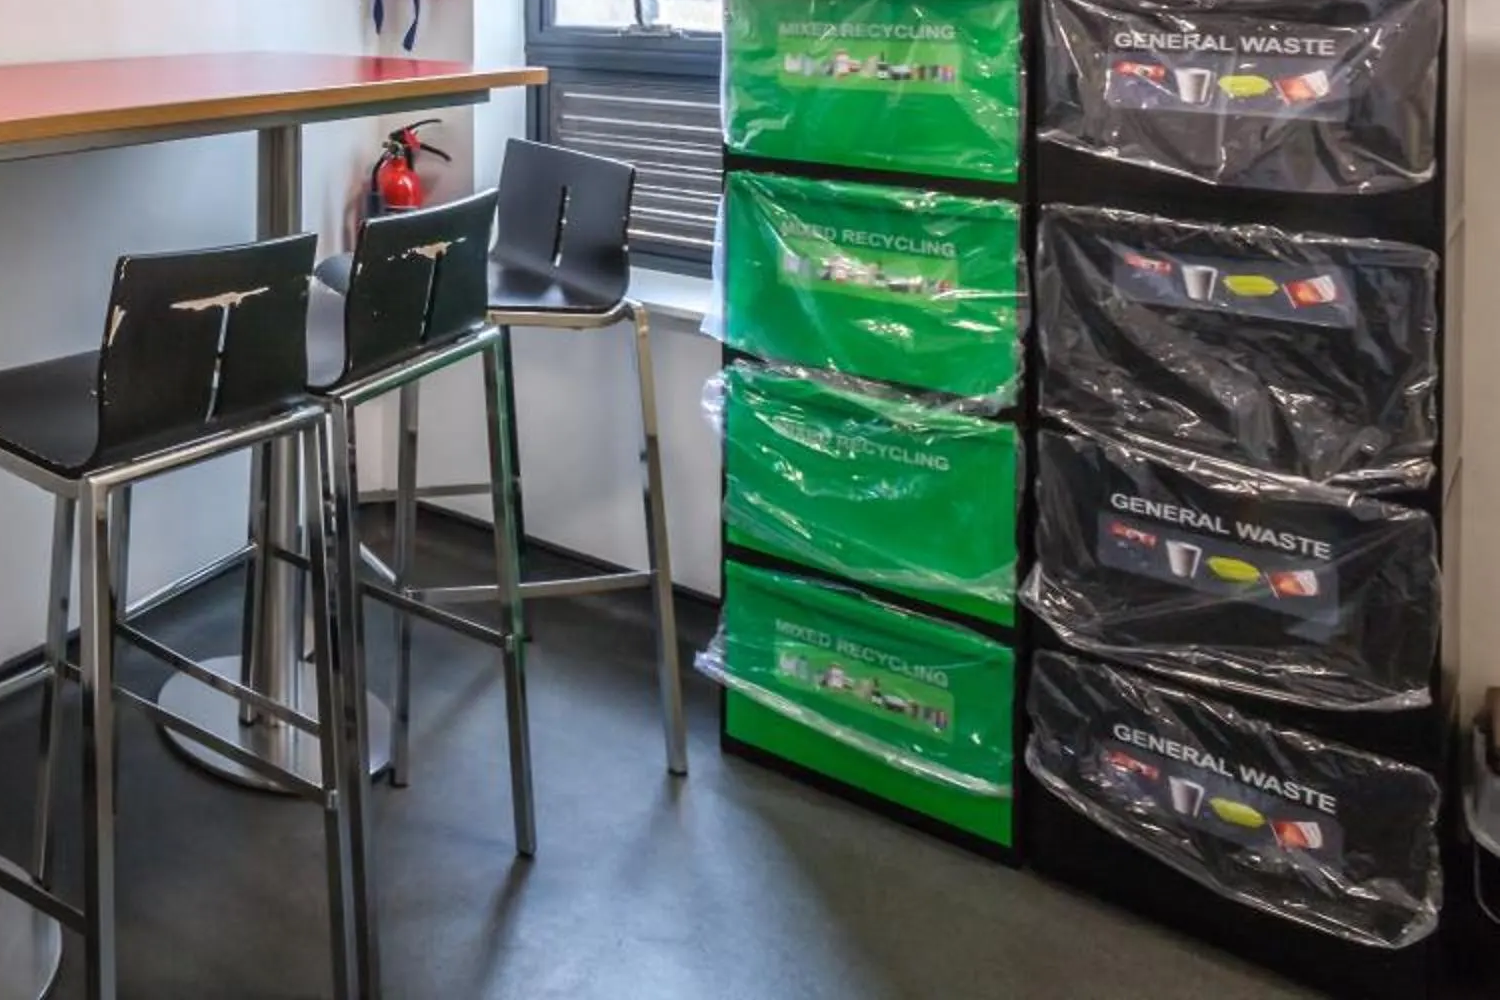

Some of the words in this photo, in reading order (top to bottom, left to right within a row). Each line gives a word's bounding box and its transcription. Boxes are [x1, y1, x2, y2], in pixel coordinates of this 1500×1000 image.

[778, 22, 838, 37] MIXED
[839, 22, 957, 40] RECYCLING
[1114, 32, 1235, 51] GENERAL
[1240, 36, 1336, 56] WASTE
[841, 229, 956, 258] RECYCLING
[835, 435, 950, 471] RECYCLING
[1110, 492, 1231, 535] GENERAL
[1235, 520, 1332, 561] WASTE
[775, 618, 833, 648] MIXED
[836, 638, 949, 688] RECYCLING
[1113, 723, 1234, 777] GENERAL
[1238, 764, 1337, 815] WASTE
